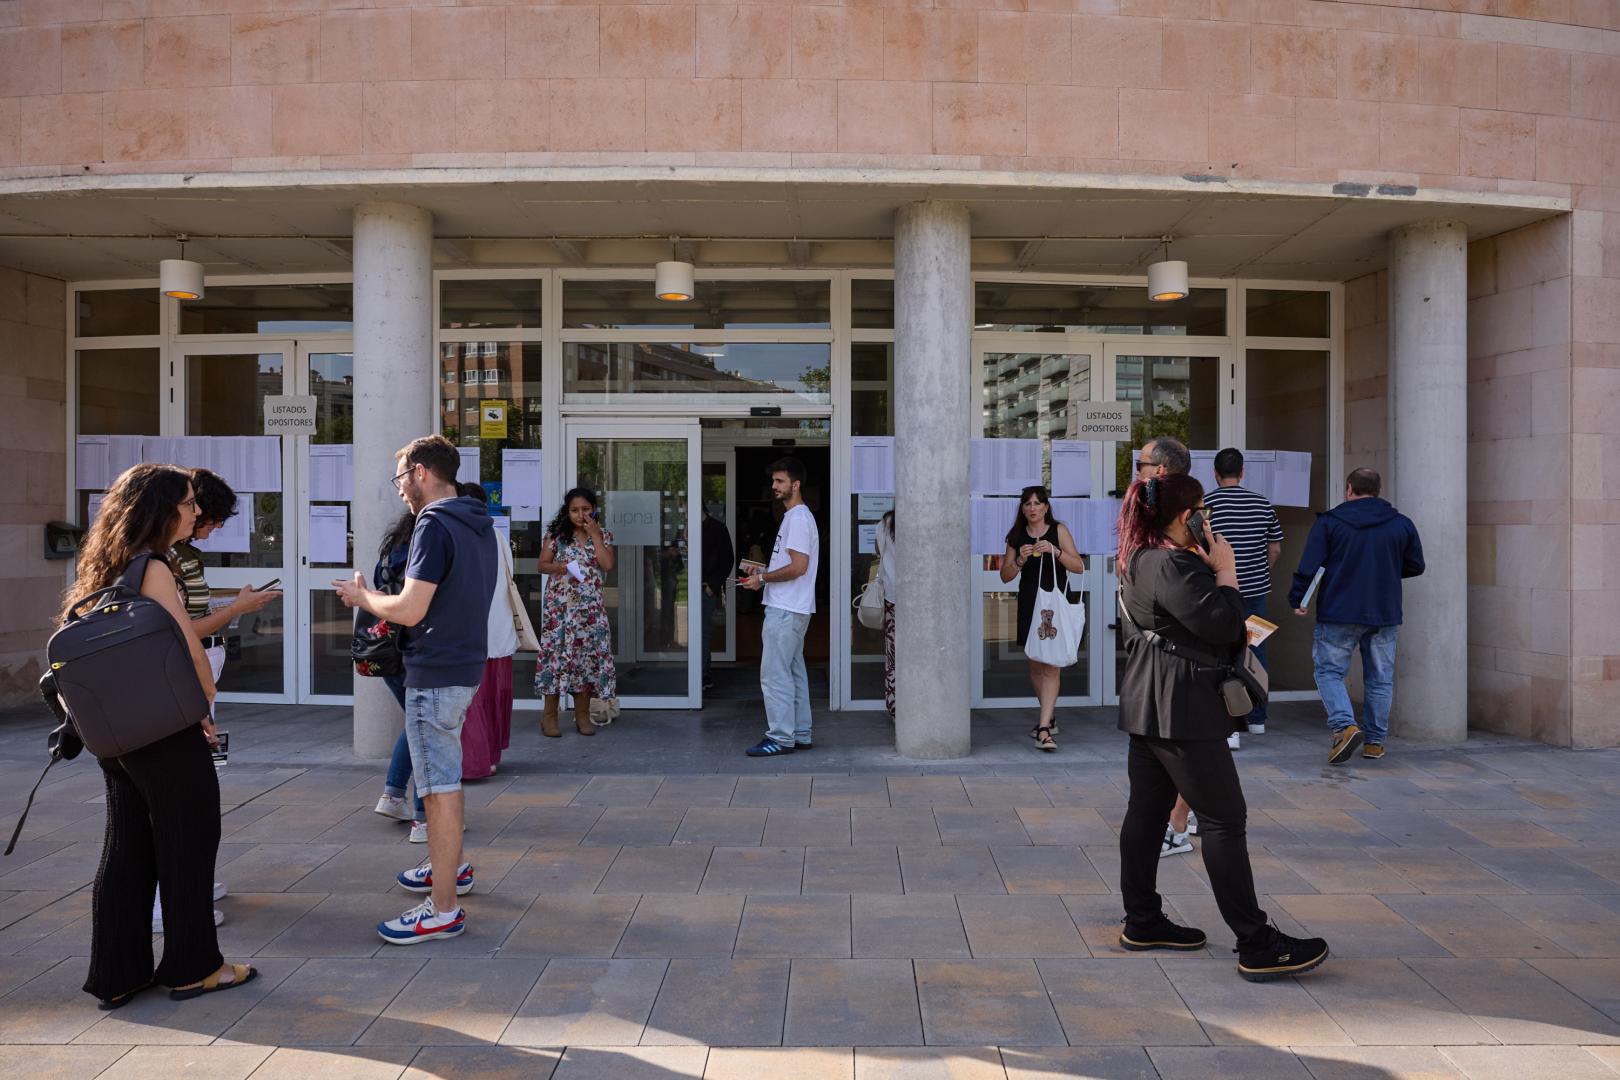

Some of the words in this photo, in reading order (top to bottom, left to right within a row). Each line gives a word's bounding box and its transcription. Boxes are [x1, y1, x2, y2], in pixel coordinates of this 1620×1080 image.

[1086, 412, 1122, 420] LISTADOS
[267, 418, 313, 426] OPOSITORES
[1081, 424, 1129, 432] OPOSITORES
[613, 511, 654, 528] upna
